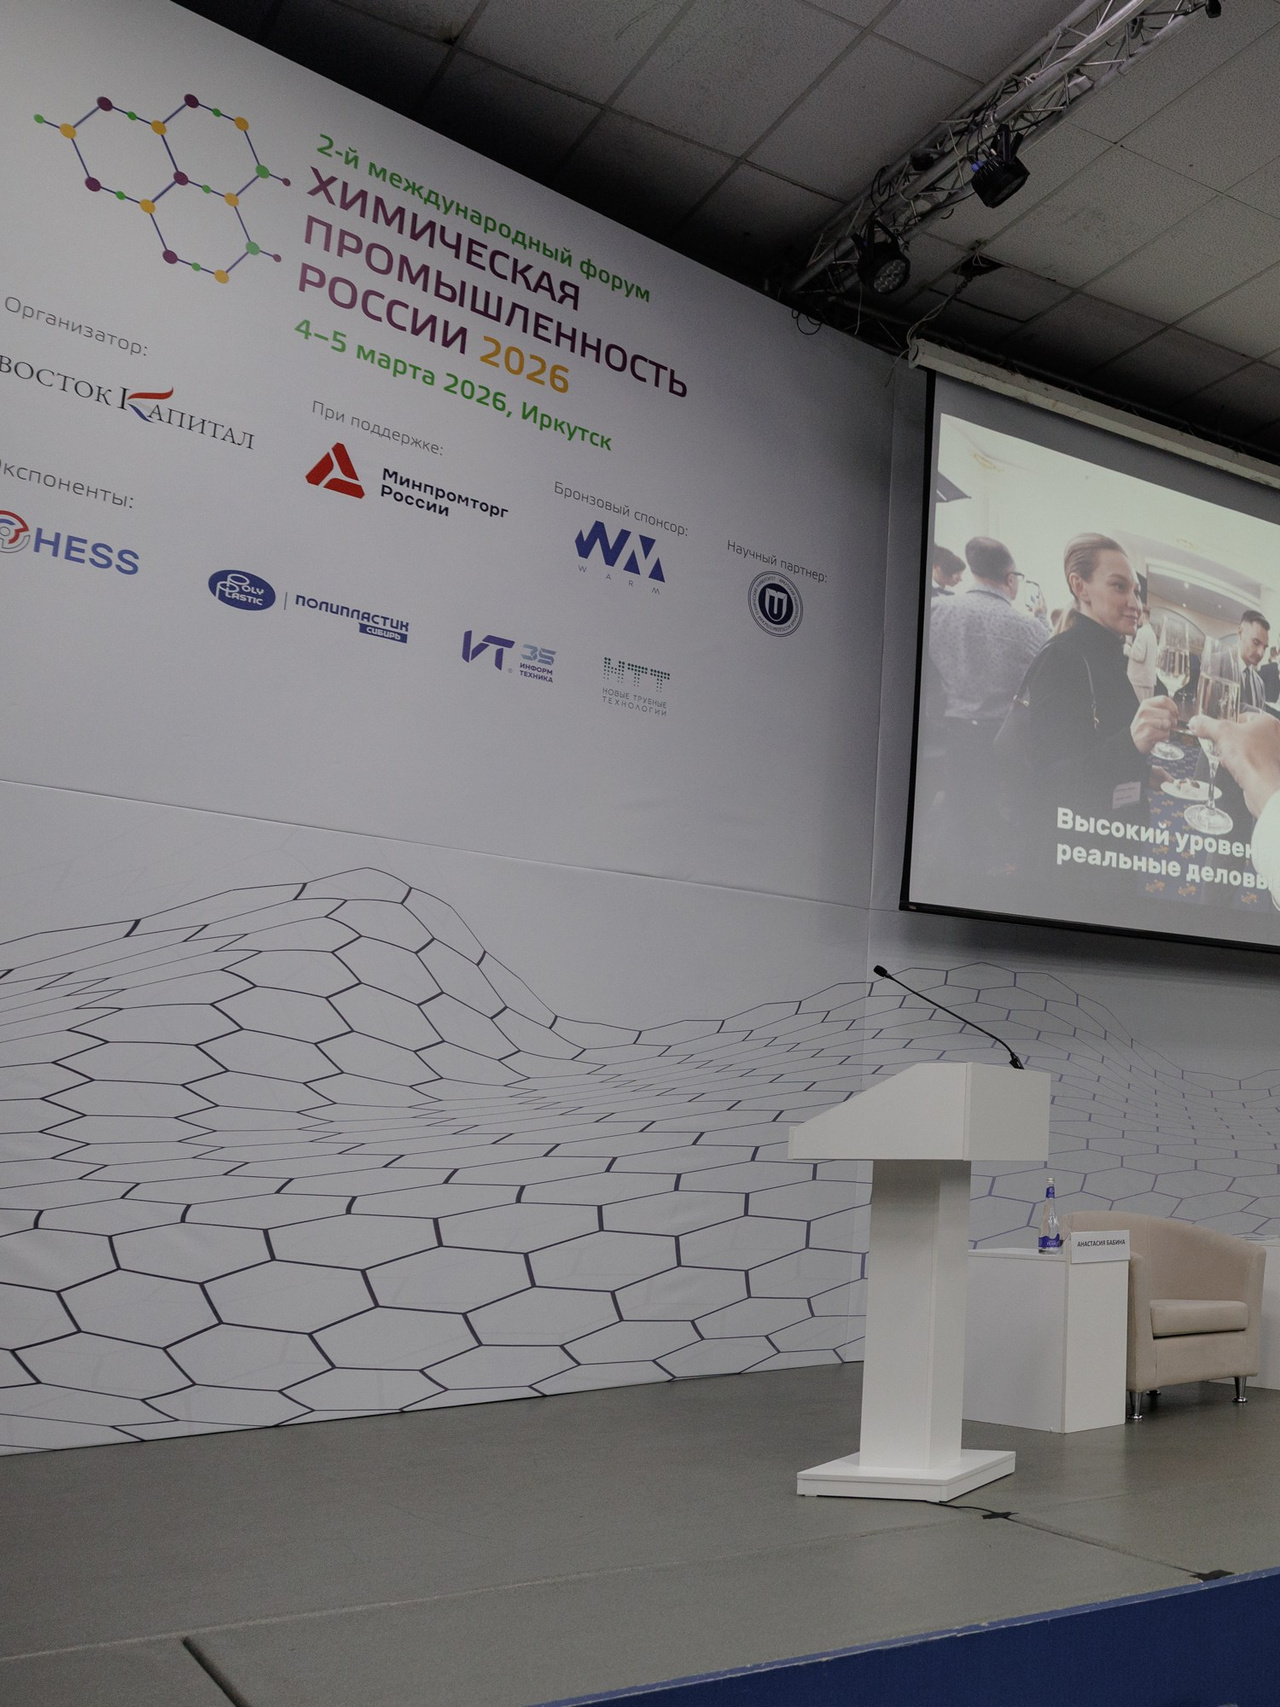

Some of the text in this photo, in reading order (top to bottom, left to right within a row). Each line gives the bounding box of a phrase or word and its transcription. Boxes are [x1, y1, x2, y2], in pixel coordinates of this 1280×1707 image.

[306, 165, 580, 311] ХИМИЧЕСКАЯ
[316, 133, 651, 303] 2-й международный форум
[4, 296, 148, 356] Организатор:
[298, 262, 570, 394] РОССИИ 2026
[304, 214, 688, 398] ПРОМЫШЛЕННОСТЬ
[0, 354, 256, 450] ВОСТОК КАПИТАЛ
[356, 344, 435, 387] марта
[443, 372, 512, 418] 2026,
[521, 401, 612, 451] Иркутск
[311, 400, 444, 457] При поддержке:
[0, 458, 134, 509] кспоненты:
[380, 484, 450, 517] России
[382, 468, 509, 518] Минпромторг
[554, 480, 688, 537] Бронзовый спонсор:
[33, 527, 139, 575] HESS
[727, 539, 828, 583] Научный партнер:
[295, 594, 410, 633] ПОЛИПЛАСТИК
[365, 626, 401, 641] СИБИРЬ
[519, 662, 554, 676] ИНФОРМ
[519, 670, 554, 684] ТЕХНИКА
[520, 643, 557, 666] 35
[602, 686, 667, 709] НОВЫЕ ТРУБНЫЕ
[602, 695, 667, 717] ТЕХНОЛОГИИ
[1057, 806, 1266, 861] Высокий уровен
[1056, 842, 1181, 877] реальные
[1077, 1240, 1106, 1248] АНАСТАСИЯ
